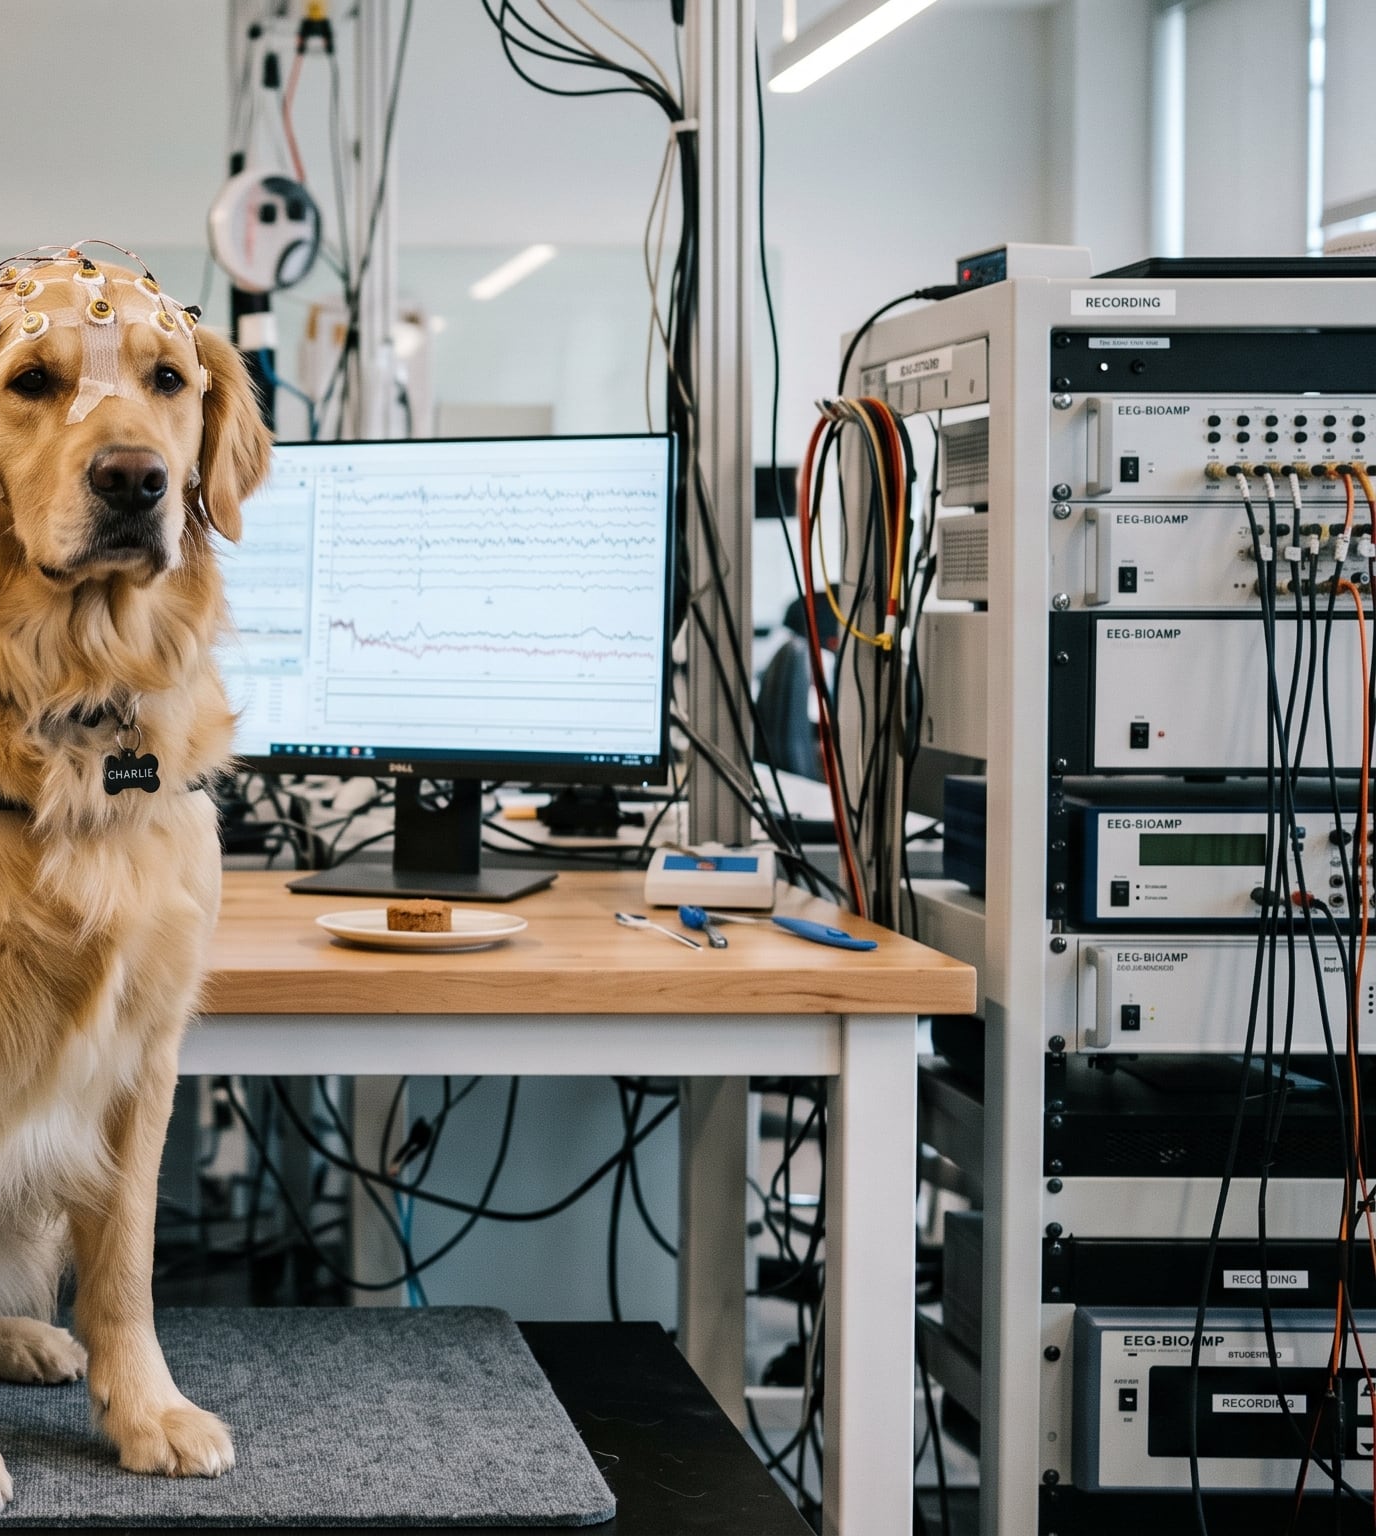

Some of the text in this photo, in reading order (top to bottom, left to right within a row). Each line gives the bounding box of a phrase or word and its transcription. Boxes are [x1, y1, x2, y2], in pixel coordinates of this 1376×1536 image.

[1085, 296, 1161, 309] RECORDING
[1118, 405, 1190, 415] EEG-BIOAMP
[1116, 514, 1189, 524] EEG-BIOAMP
[1106, 628, 1181, 639] EEG-BIOAMP
[108, 768, 154, 780] CHARLIE
[1232, 1274, 1297, 1284] RECODING
[1124, 1335, 1224, 1347] EEG-BIOMP
